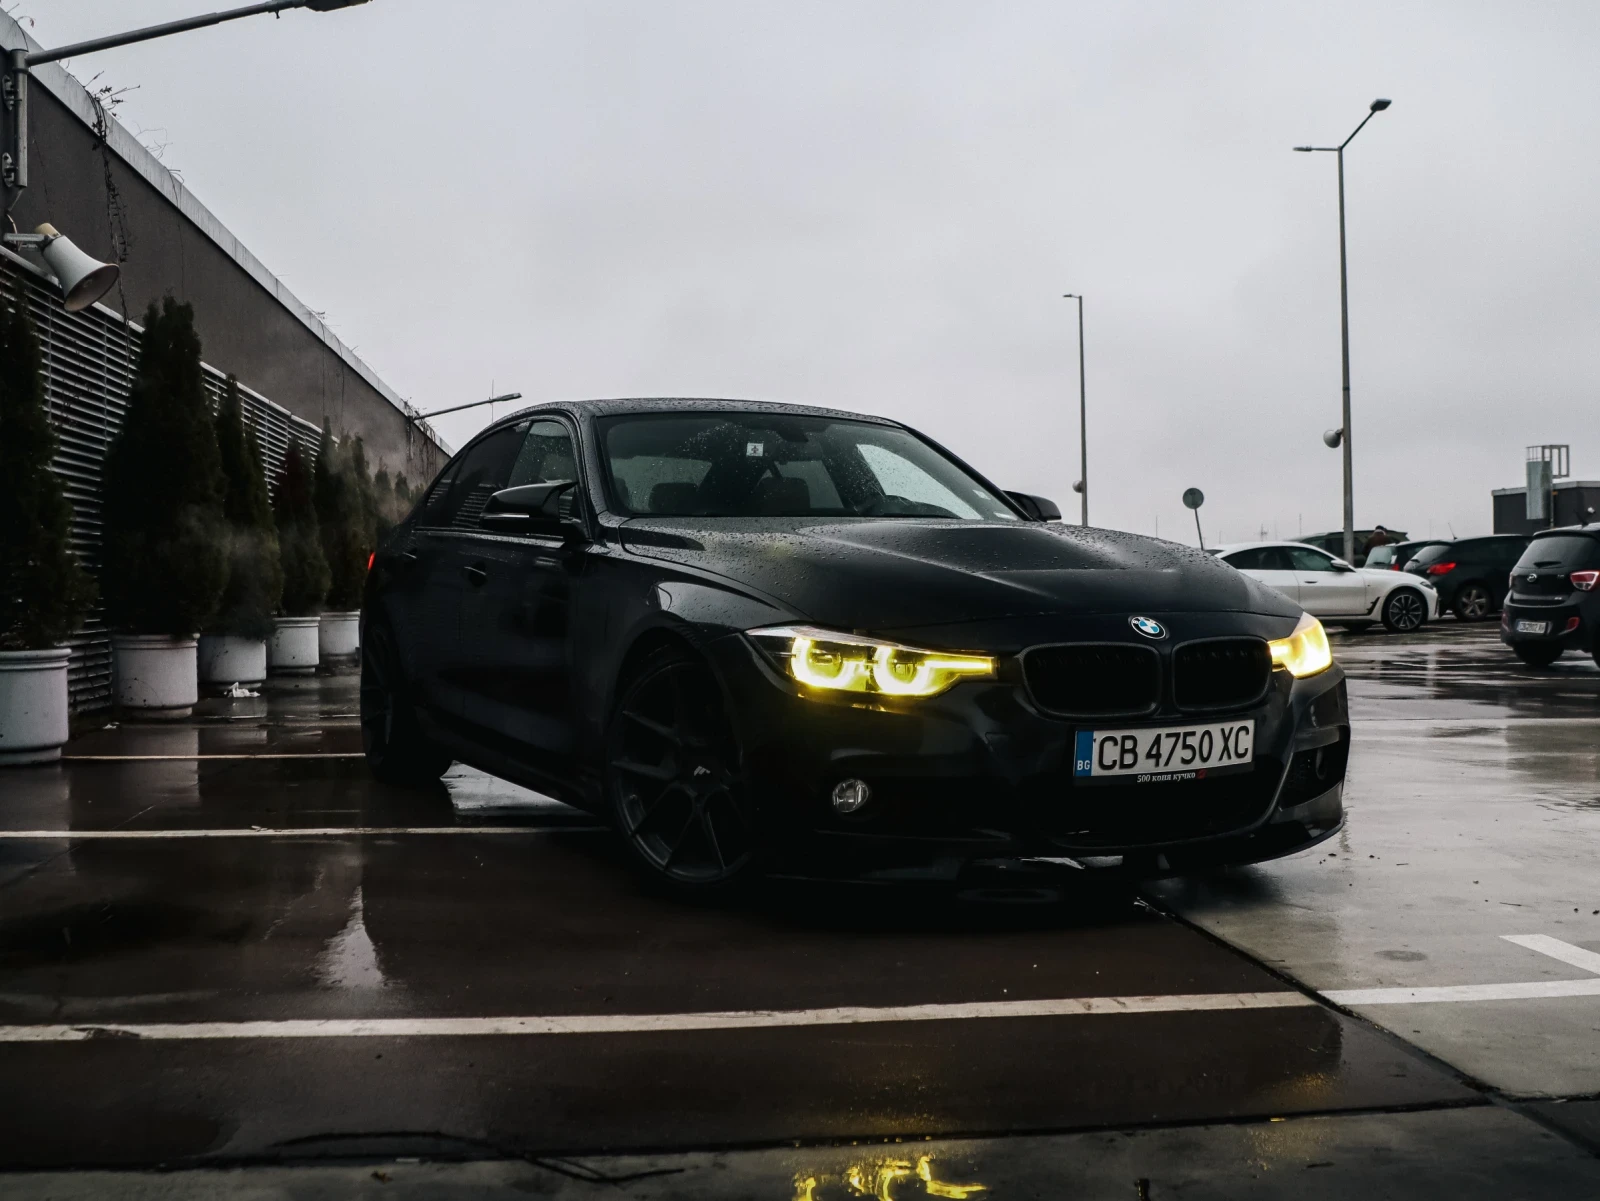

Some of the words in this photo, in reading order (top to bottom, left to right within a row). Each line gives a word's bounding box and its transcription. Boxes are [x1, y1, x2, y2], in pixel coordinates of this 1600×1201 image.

[1098, 735, 1138, 771] CB
[1145, 730, 1213, 768] 4750
[1218, 726, 1250, 762] XC
[1077, 760, 1090, 771] BG
[1137, 774, 1151, 783] 500
